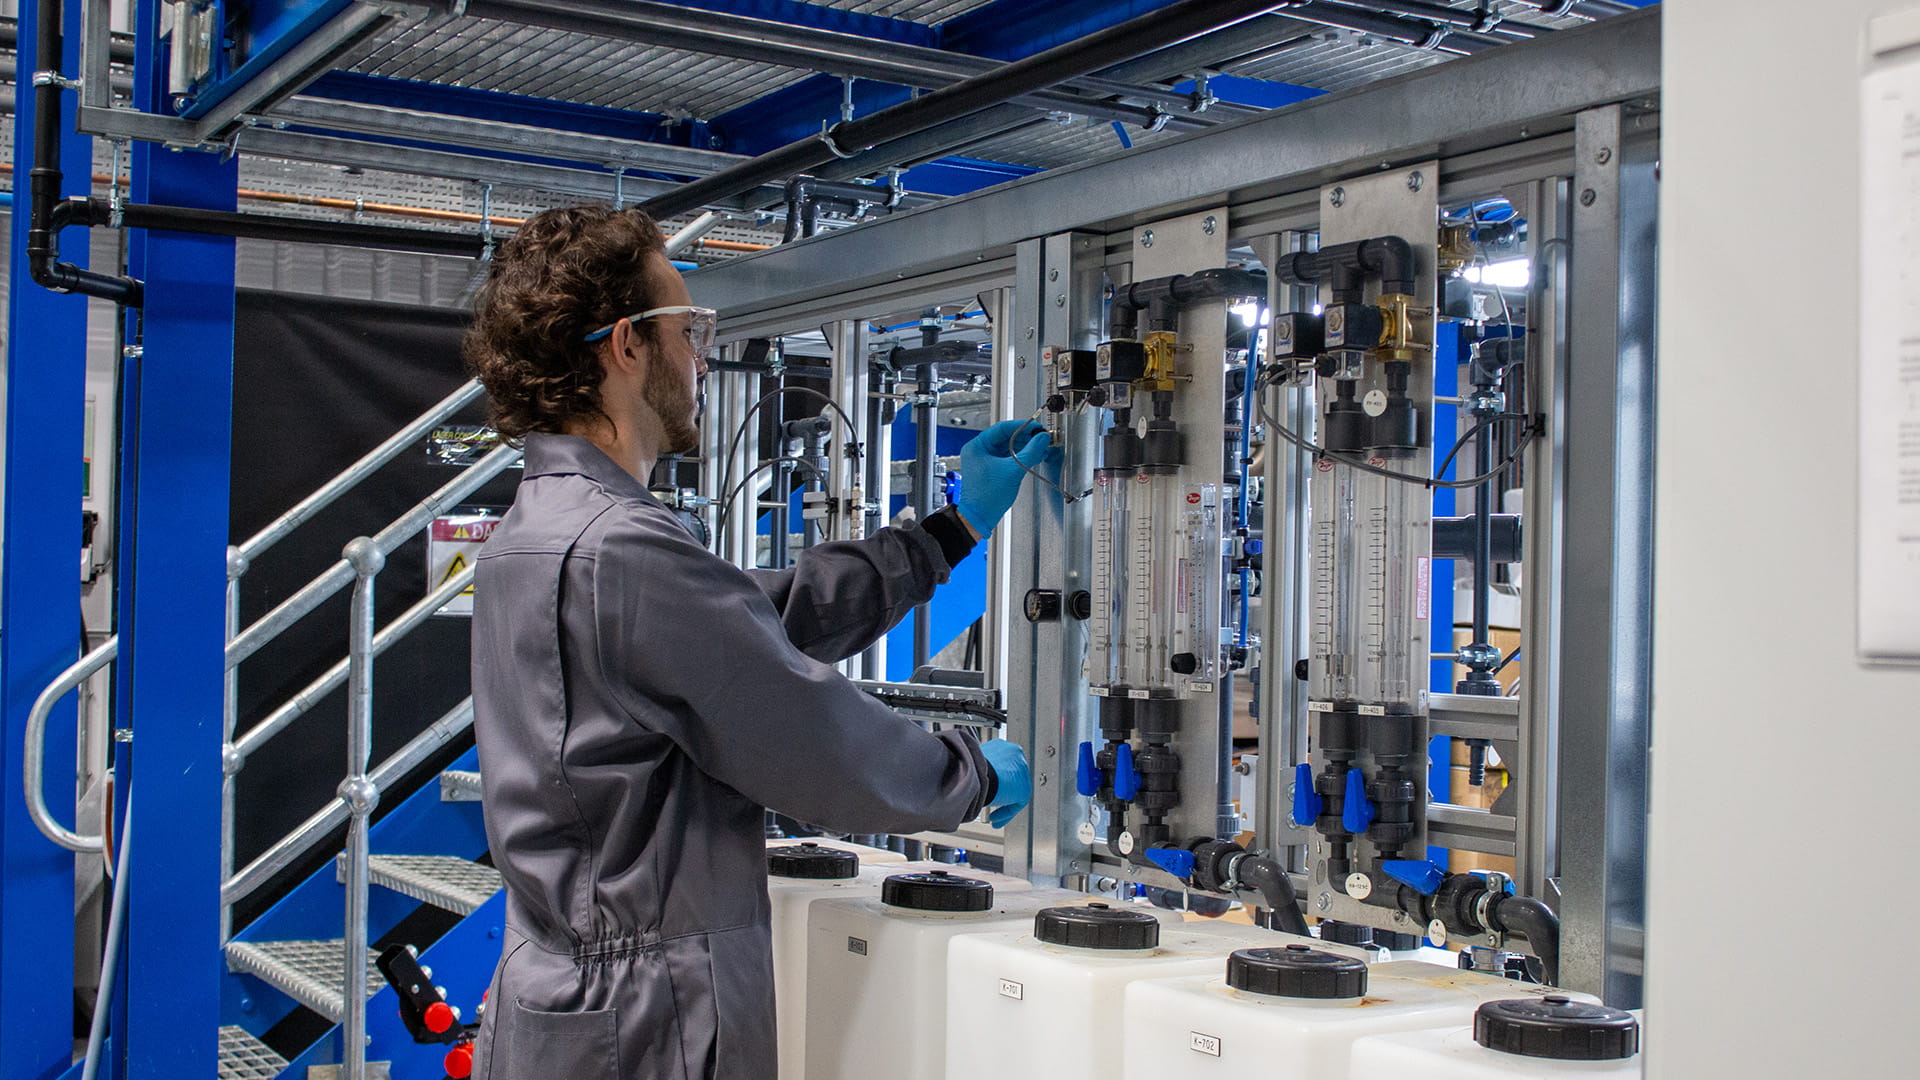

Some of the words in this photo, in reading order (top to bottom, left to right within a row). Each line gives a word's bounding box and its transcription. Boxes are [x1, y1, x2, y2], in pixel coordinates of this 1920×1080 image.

[432, 431, 453, 439] LASER
[1002, 983, 1018, 995] K-701
[1193, 1037, 1215, 1051] K-702
